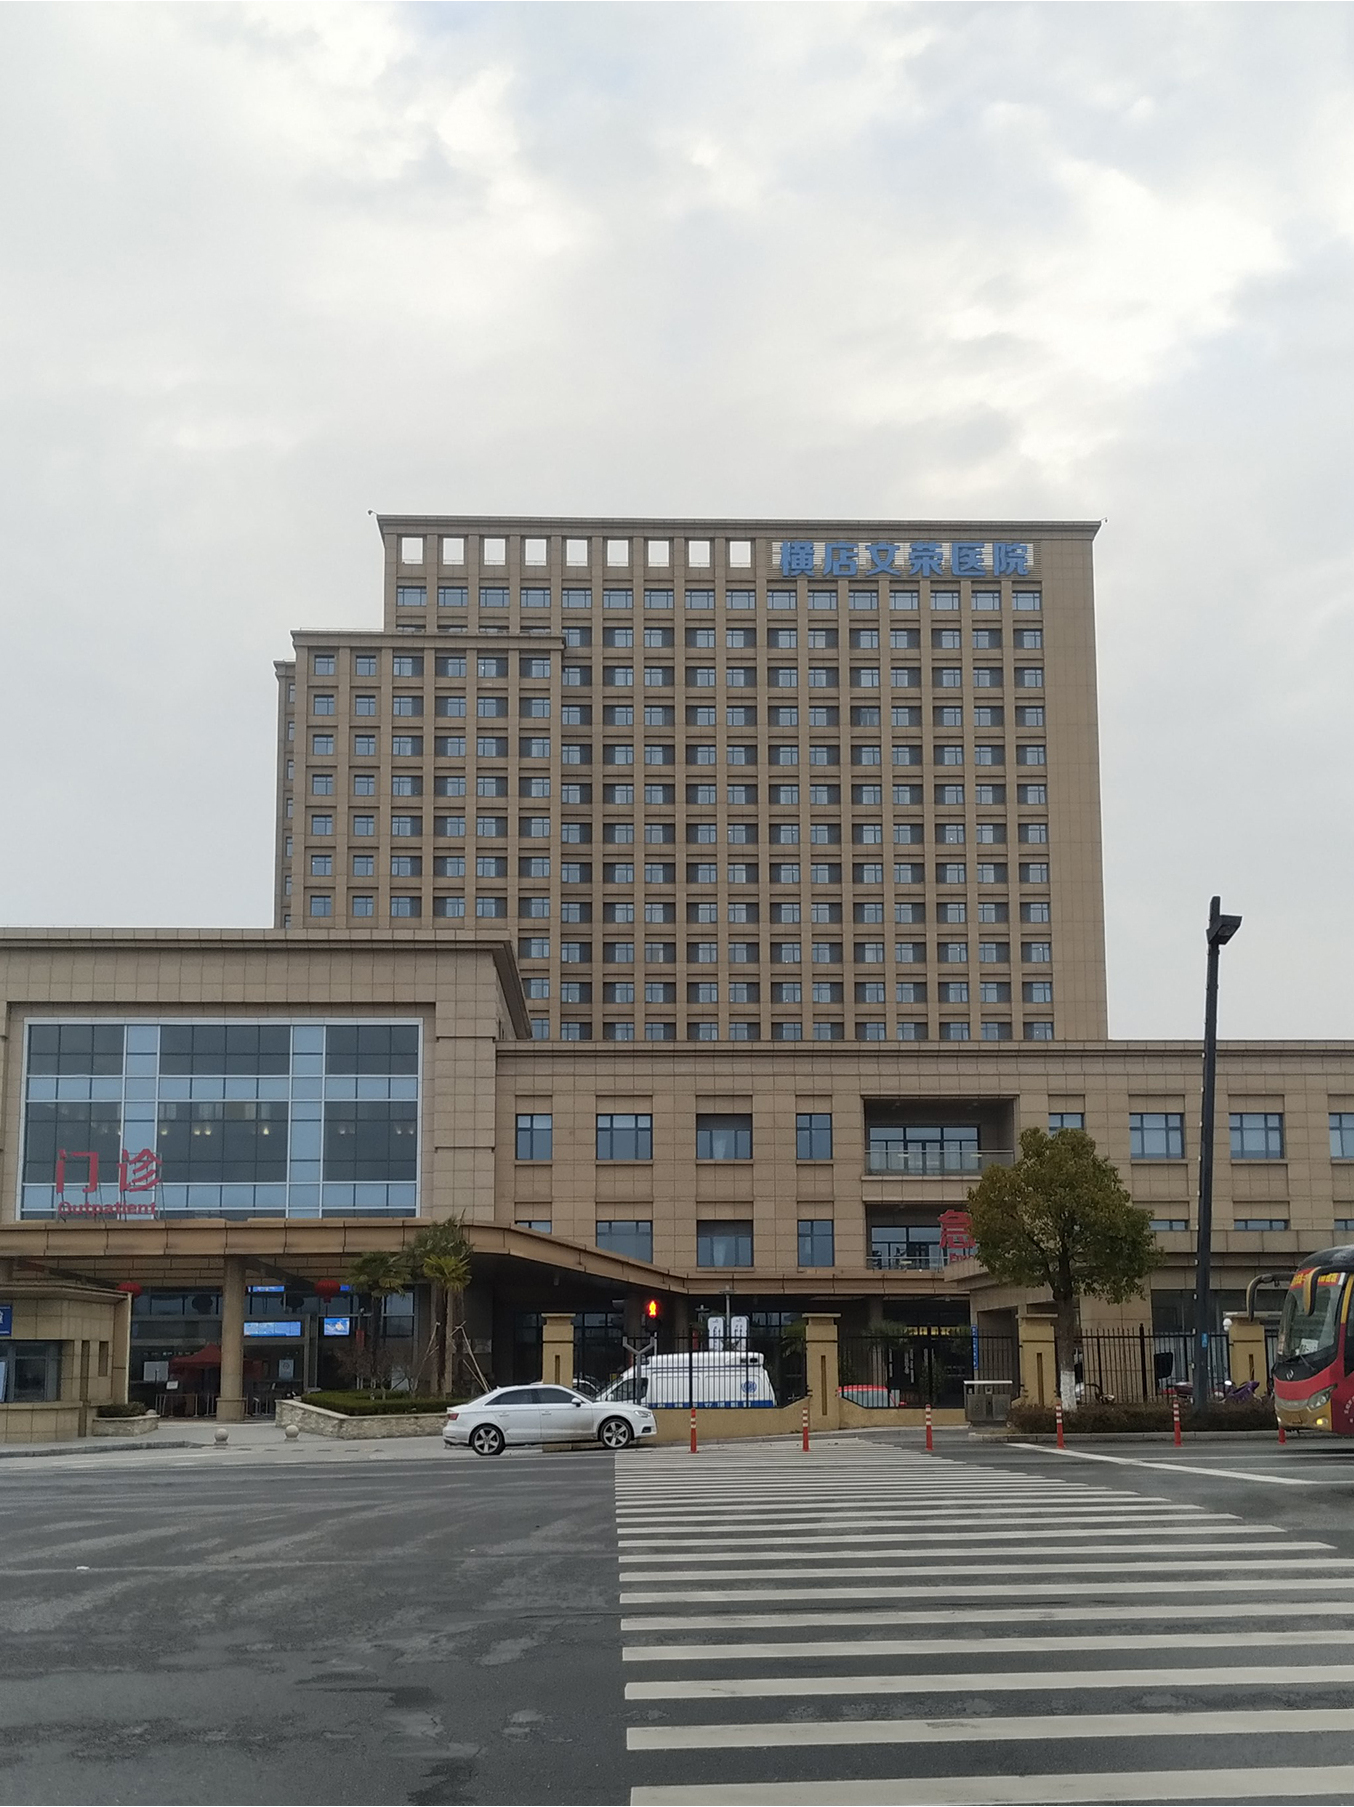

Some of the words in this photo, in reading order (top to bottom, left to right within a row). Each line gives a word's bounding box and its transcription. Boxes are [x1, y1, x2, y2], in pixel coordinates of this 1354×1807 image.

[780, 540, 1029, 577] 横店文荣医院
[56, 1148, 162, 1193] 门诊
[58, 1201, 156, 1216] Outpatient
